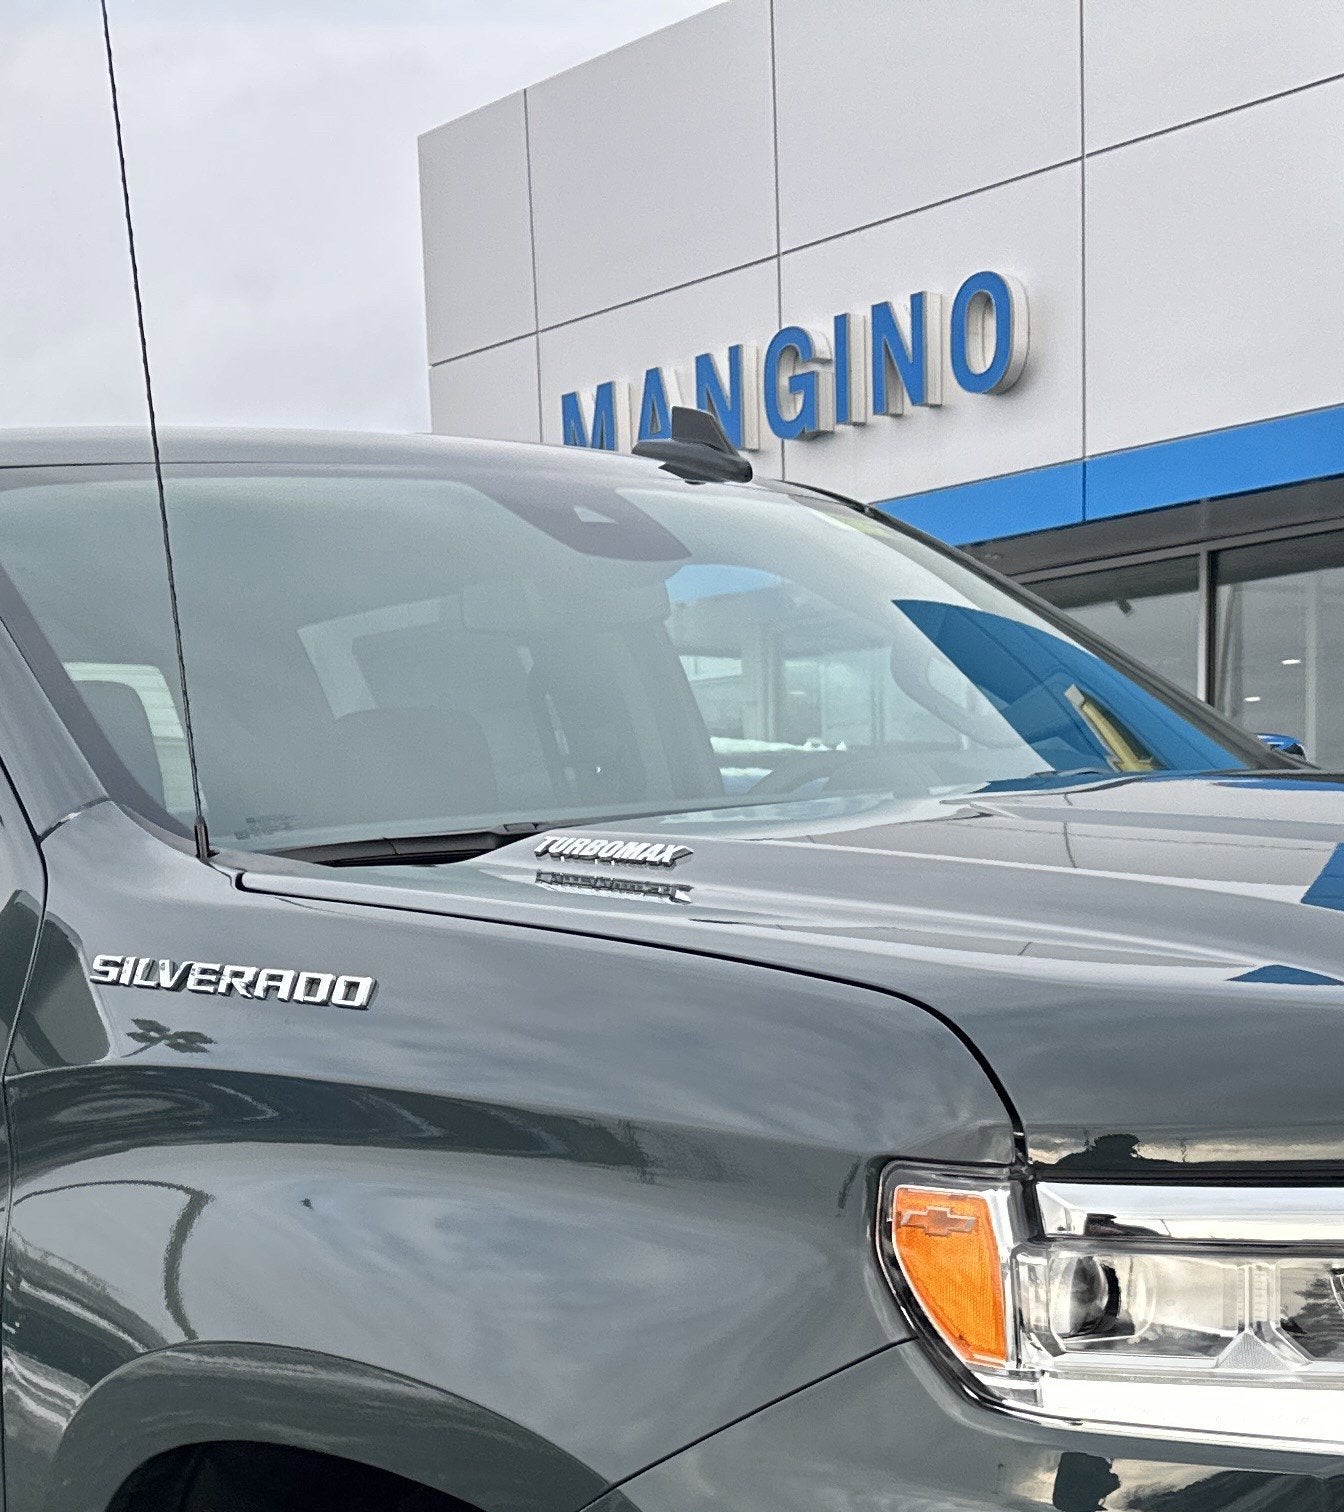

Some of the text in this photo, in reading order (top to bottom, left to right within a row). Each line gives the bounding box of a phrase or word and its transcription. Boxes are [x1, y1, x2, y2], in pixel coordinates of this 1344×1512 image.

[561, 269, 1024, 450] MANGINO
[533, 836, 695, 865] TURBOMAX
[89, 954, 375, 1009] SILVERADO
